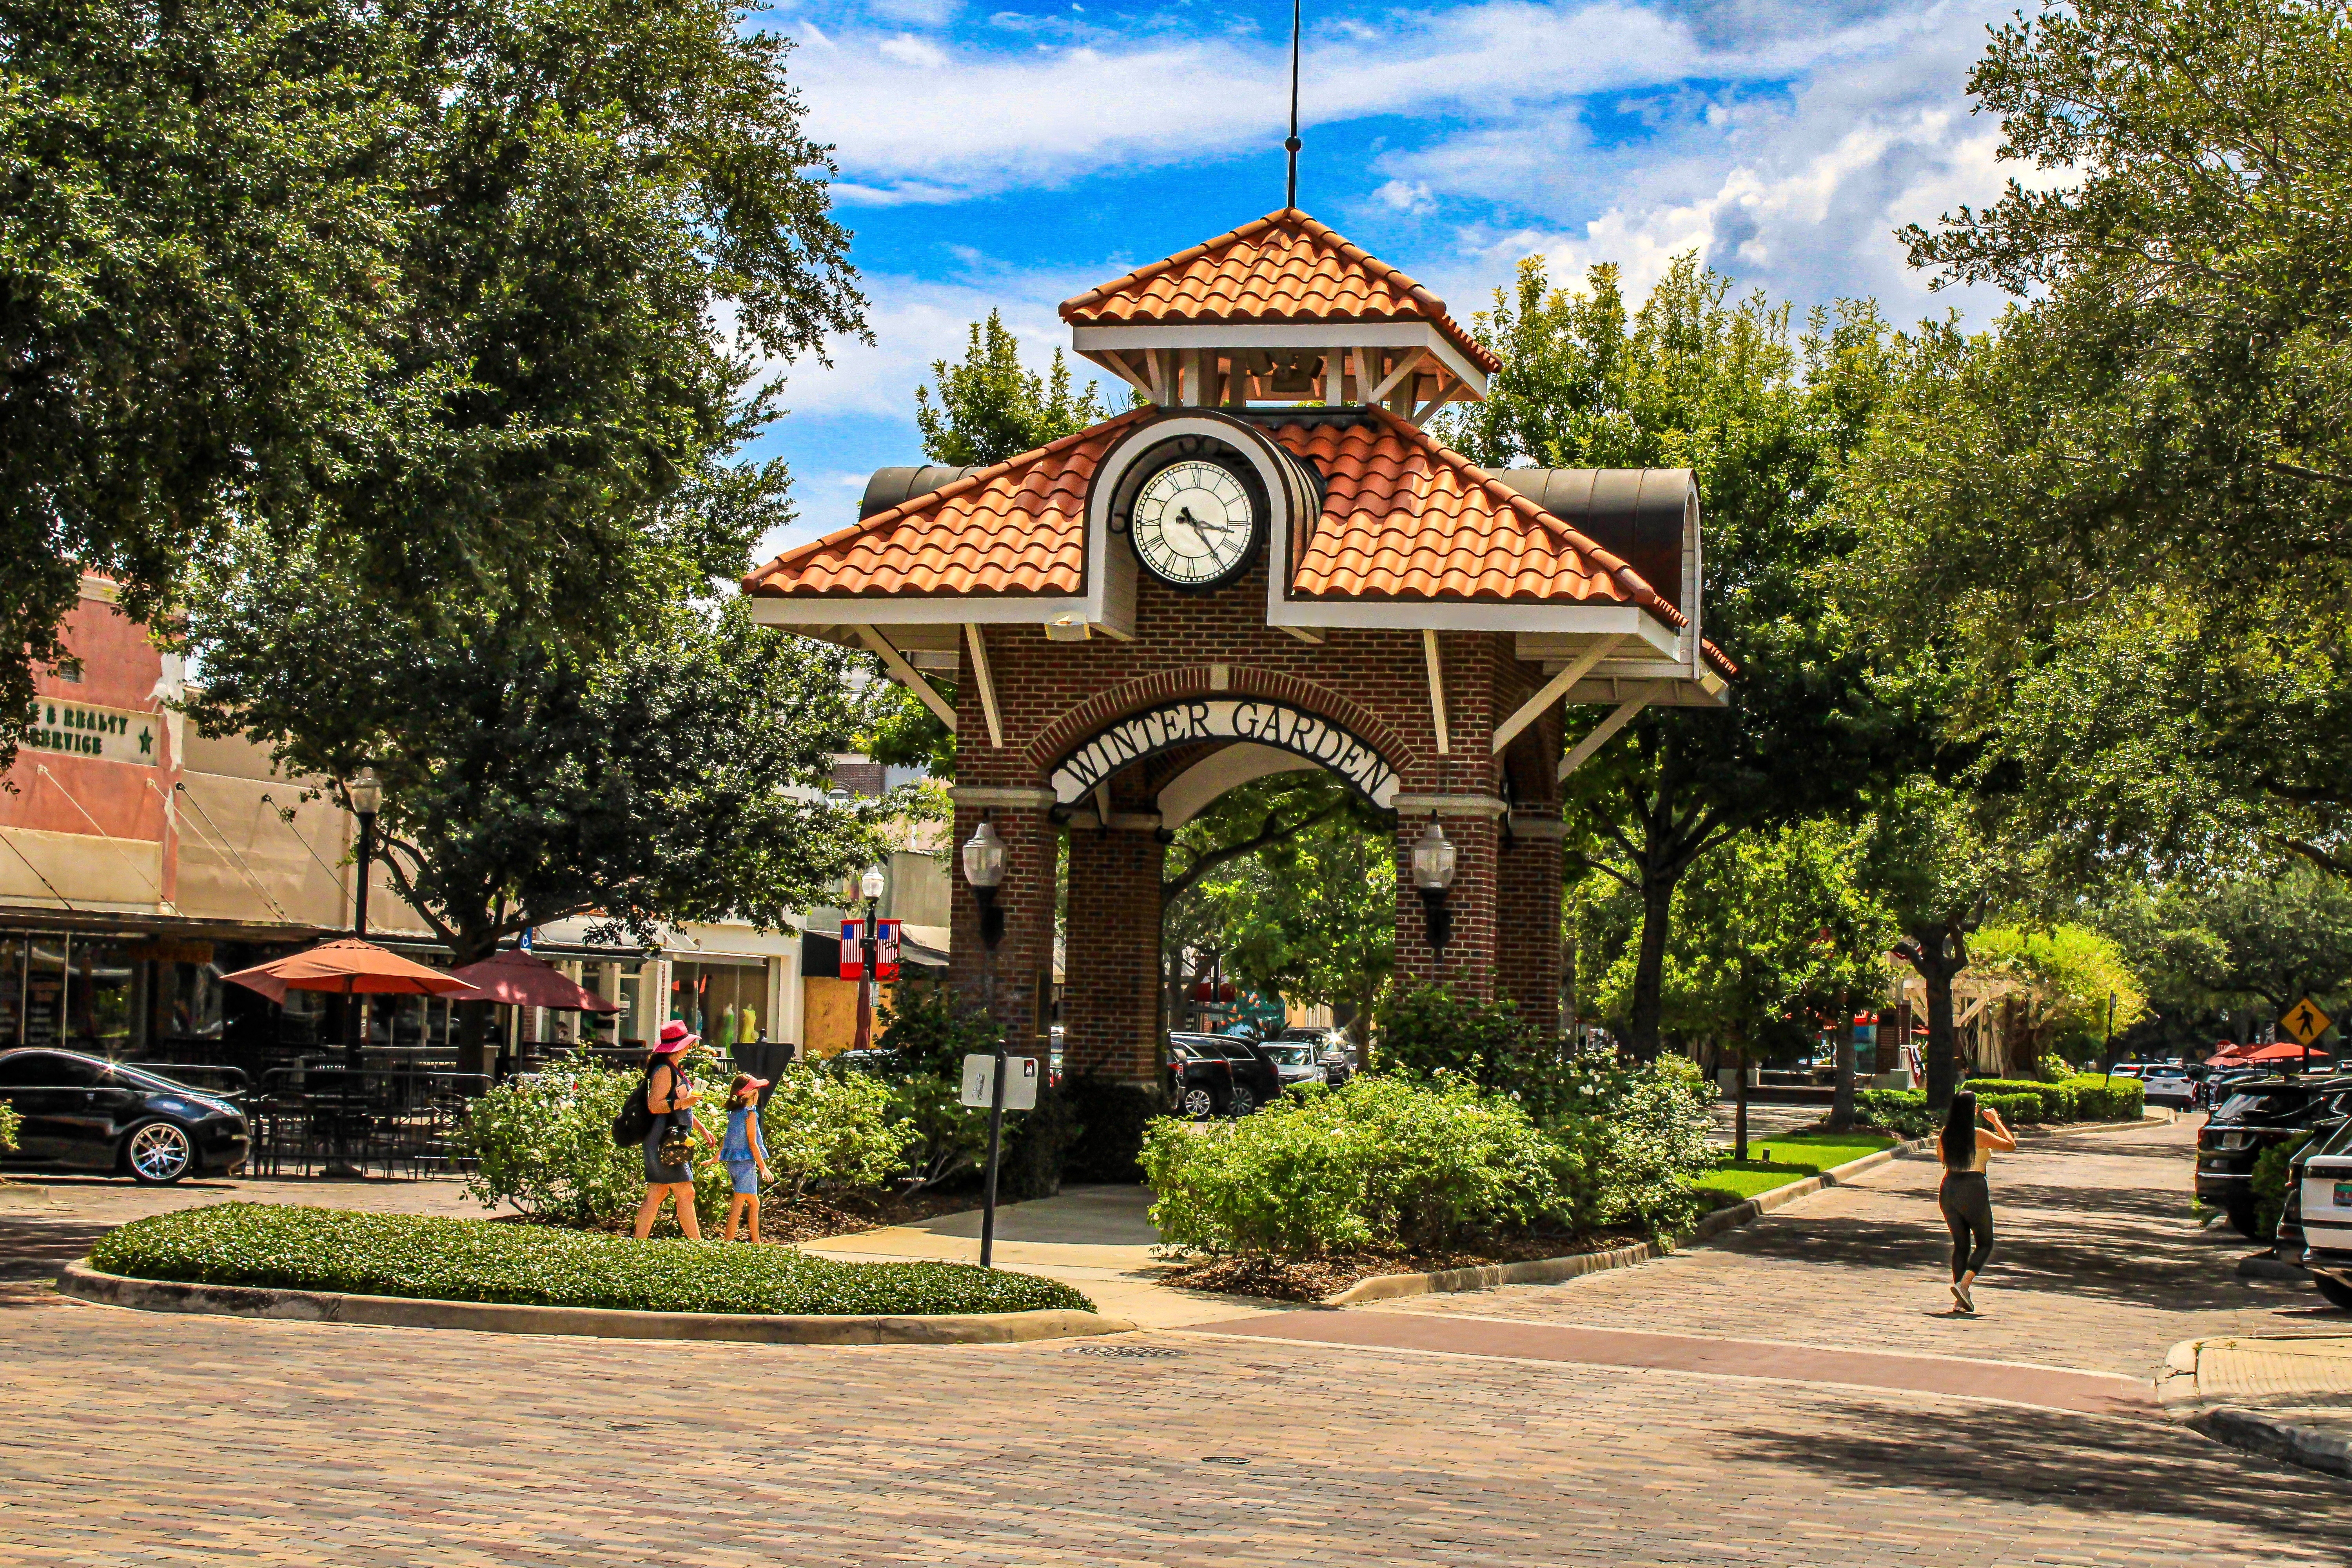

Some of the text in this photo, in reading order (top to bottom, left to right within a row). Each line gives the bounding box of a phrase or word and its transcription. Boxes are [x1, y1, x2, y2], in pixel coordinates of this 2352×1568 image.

[64, 708, 129, 735] REALTY
[1063, 702, 1396, 797] WINTER GARDEN
